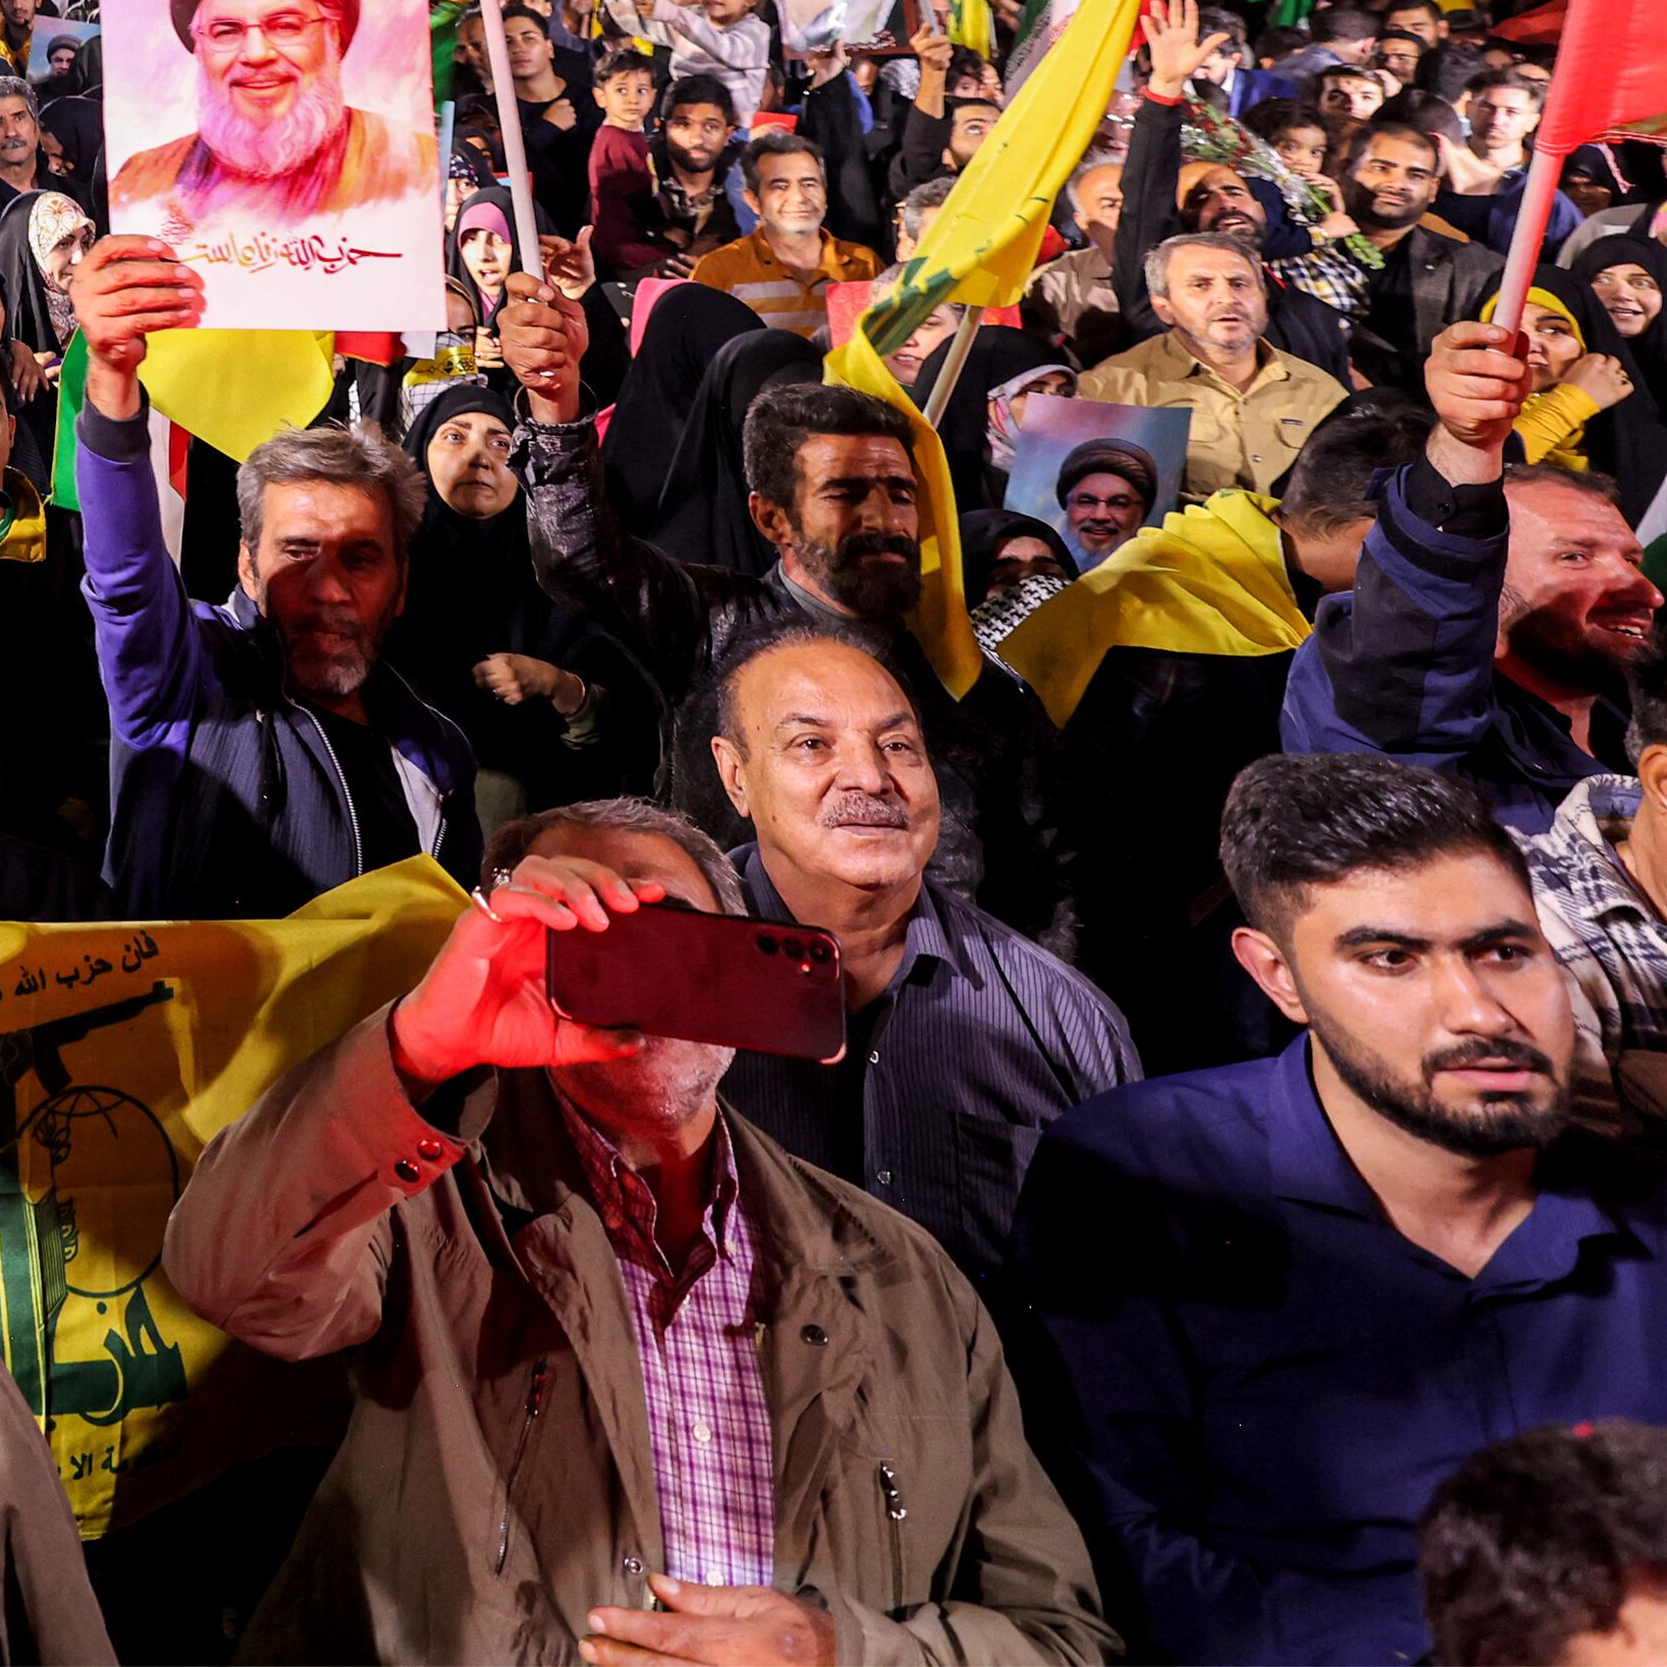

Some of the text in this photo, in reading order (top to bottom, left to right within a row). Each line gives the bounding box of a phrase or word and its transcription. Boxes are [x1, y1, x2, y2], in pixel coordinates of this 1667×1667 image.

[121, 930, 160, 973] فان
[14, 964, 47, 997] الله
[55, 954, 113, 989] حزب
